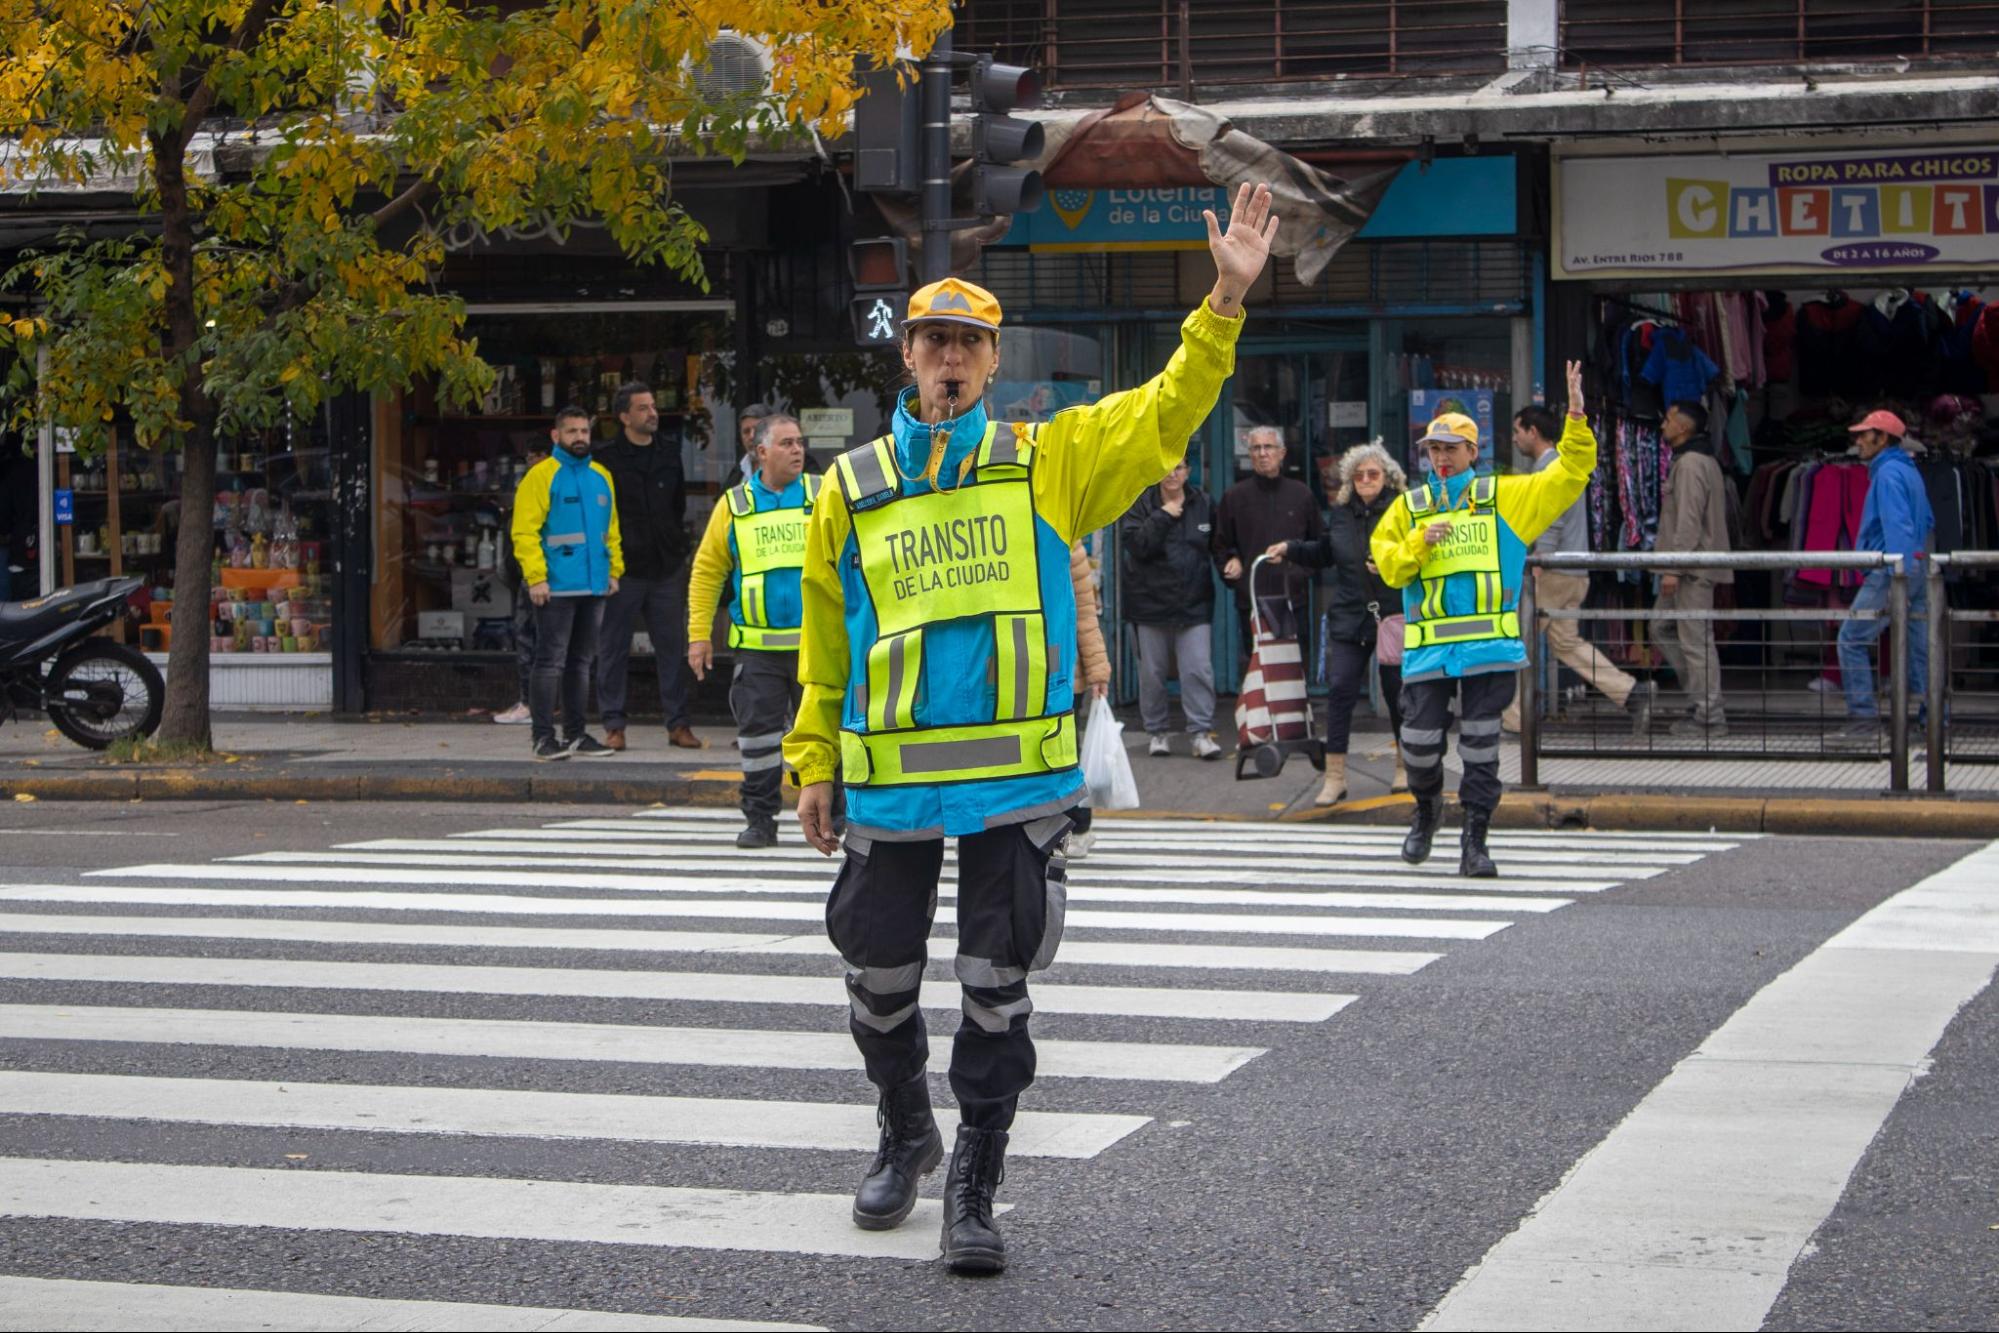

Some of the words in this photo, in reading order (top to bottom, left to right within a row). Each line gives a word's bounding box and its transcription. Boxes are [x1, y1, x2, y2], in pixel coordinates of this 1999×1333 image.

[1778, 164, 1838, 182] ROPA
[1845, 161, 1905, 179] PARA
[1910, 158, 1992, 176] CHICOS
[1109, 207, 1135, 224] de
[1143, 207, 1160, 223] la
[1167, 204, 1229, 223] Ciua
[1677, 185, 1999, 232] CHETIT
[1659, 252, 1683, 262] 788
[1833, 250, 1848, 259] DE
[1850, 250, 1858, 259] 2
[1861, 250, 1870, 259] A
[1874, 249, 1890, 259] 16
[1894, 247, 1925, 258] AÑOS
[756, 547, 767, 558] DE
[769, 545, 779, 555] LA
[781, 543, 806, 554] CIUDA
[884, 514, 1008, 574] TRANSITO
[1442, 548, 1454, 560] LA
[1455, 545, 1489, 557] CIUDAD
[894, 579, 917, 601] DE
[919, 571, 942, 593] LA
[946, 561, 1010, 589] CIUDAD
